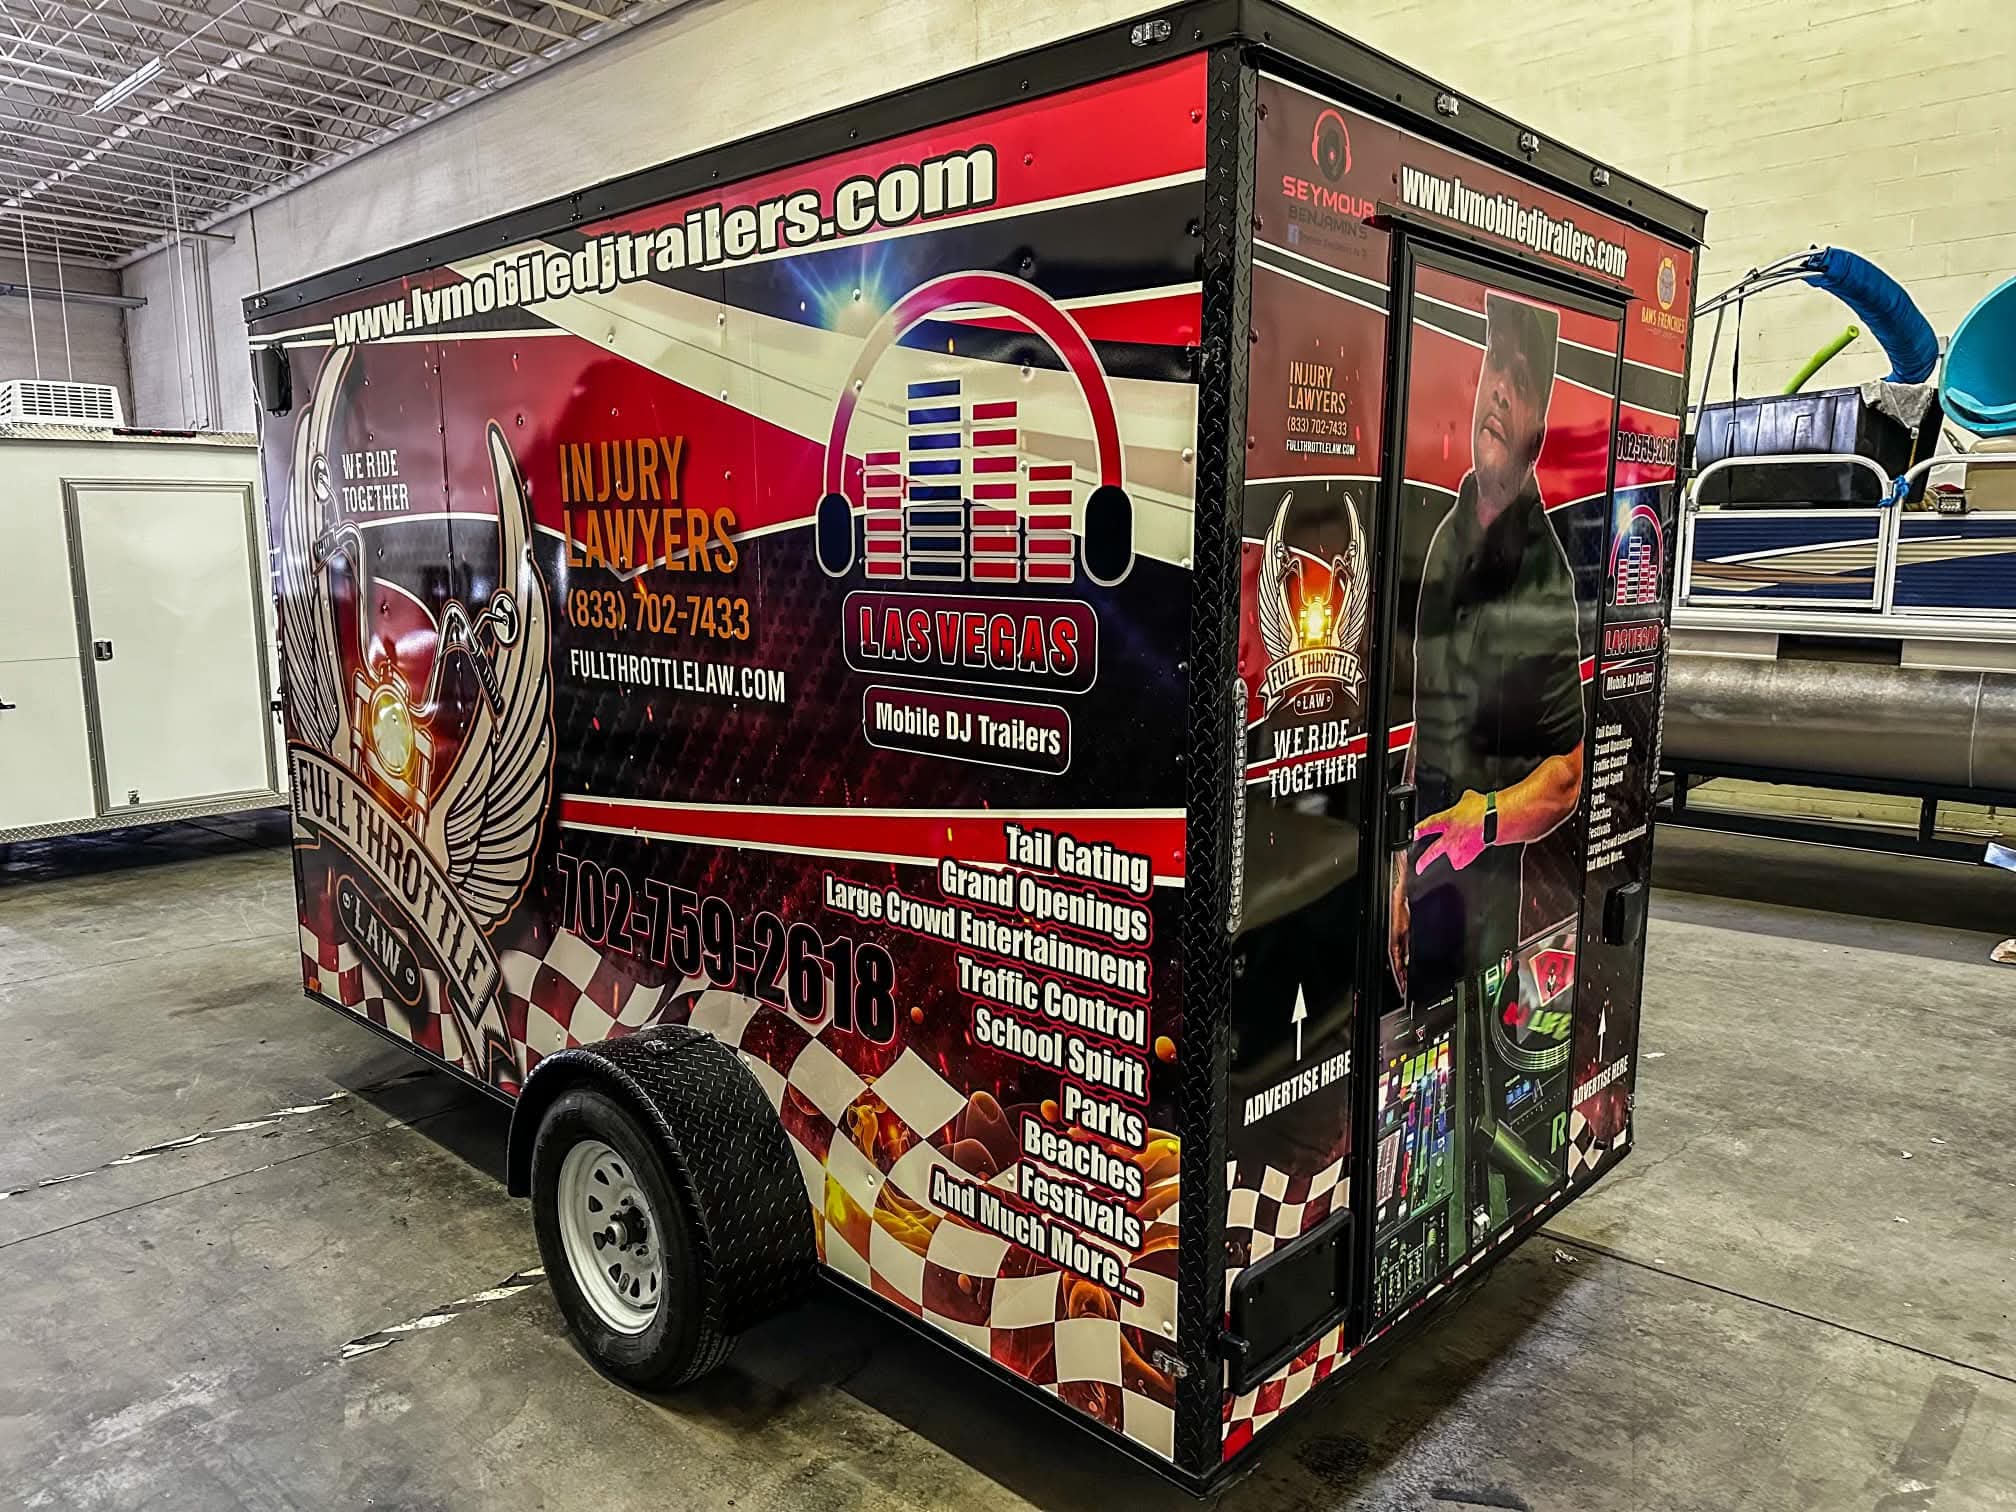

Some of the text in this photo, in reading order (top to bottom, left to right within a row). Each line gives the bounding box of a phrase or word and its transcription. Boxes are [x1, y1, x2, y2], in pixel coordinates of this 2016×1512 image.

[333, 147, 995, 346] www.lvmobiledjtrailers.com
[1401, 165, 1628, 279] www.lvmobiledjtrailers.com
[1288, 386, 1346, 415] LAWYERS
[1289, 361, 1333, 389] INJURY
[1286, 440, 1355, 455] FULLTHROTTLELAW.COM
[1287, 416, 1347, 436] (833) 702-7433
[1616, 430, 1677, 466] 702-759-2618
[342, 450, 398, 480] WE RIDE
[342, 483, 410, 513] TOGETHER
[559, 436, 683, 502] INJURY
[564, 507, 739, 573] LAWYERS
[568, 588, 750, 640] (833) 702-7433
[860, 606, 1079, 677] LAS VEGAS
[570, 649, 785, 703] FULLTHROTTLELAW.COM
[1270, 651, 1356, 690] FULL THROTTLE
[1302, 693, 1325, 710] LAW
[876, 702, 1061, 755] Mobile DJ Trailers
[1273, 718, 1350, 760] WE RIDE
[1269, 753, 1357, 798] TOGETHER
[297, 758, 492, 998] FULL THROTTLE
[1006, 825, 1149, 893] Tail Gating
[942, 860, 1148, 941] Grand Openings
[353, 897, 402, 976] LAW
[557, 852, 897, 1046] 702-759-2618
[826, 875, 1147, 994] Large Crowd Entertainment
[958, 956, 1145, 1045] Traffic Control
[976, 1007, 1145, 1098] School Spirit
[1572, 1054, 1629, 1109] ADVERTISE HERE
[1065, 1085, 1143, 1147] Parks
[1243, 1049, 1351, 1127] ADVERTISE HERE
[1024, 1119, 1142, 1198] Beaches
[933, 1171, 975, 1219] And
[980, 1192, 1046, 1255] Much
[1021, 1164, 1141, 1249] Festivals
